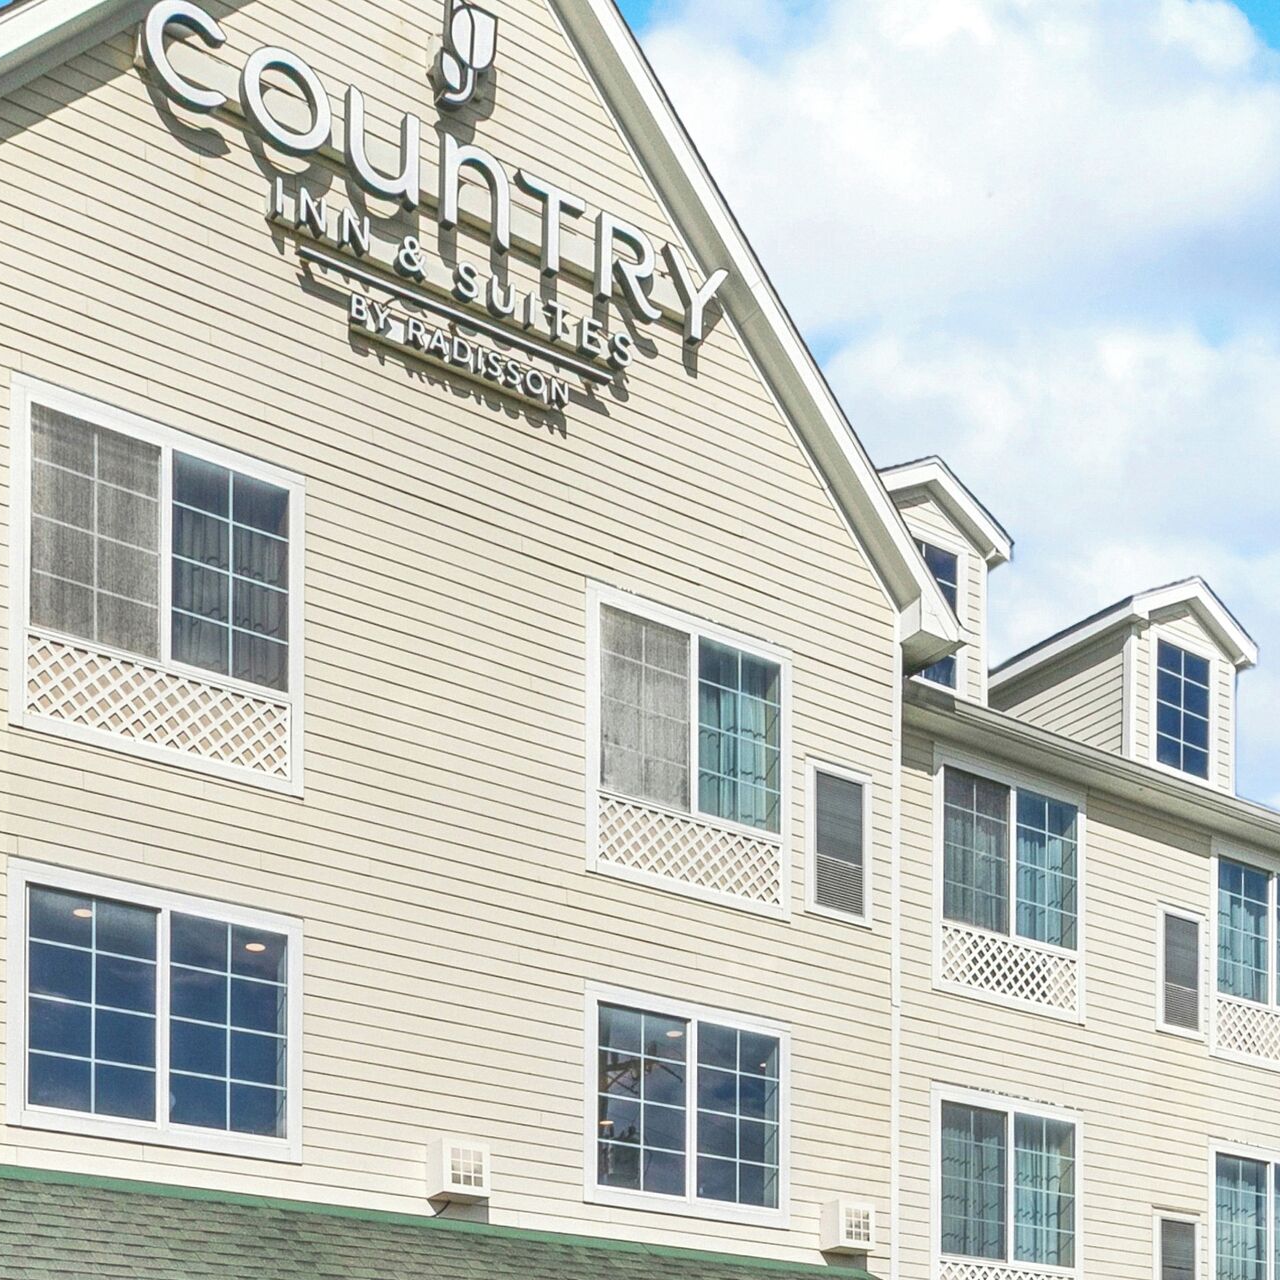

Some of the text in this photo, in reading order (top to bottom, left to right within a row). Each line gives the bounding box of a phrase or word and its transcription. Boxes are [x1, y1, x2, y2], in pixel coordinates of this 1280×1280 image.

[271, 176, 634, 370] INN & SUITES
[349, 293, 569, 408] BY RADISSON
